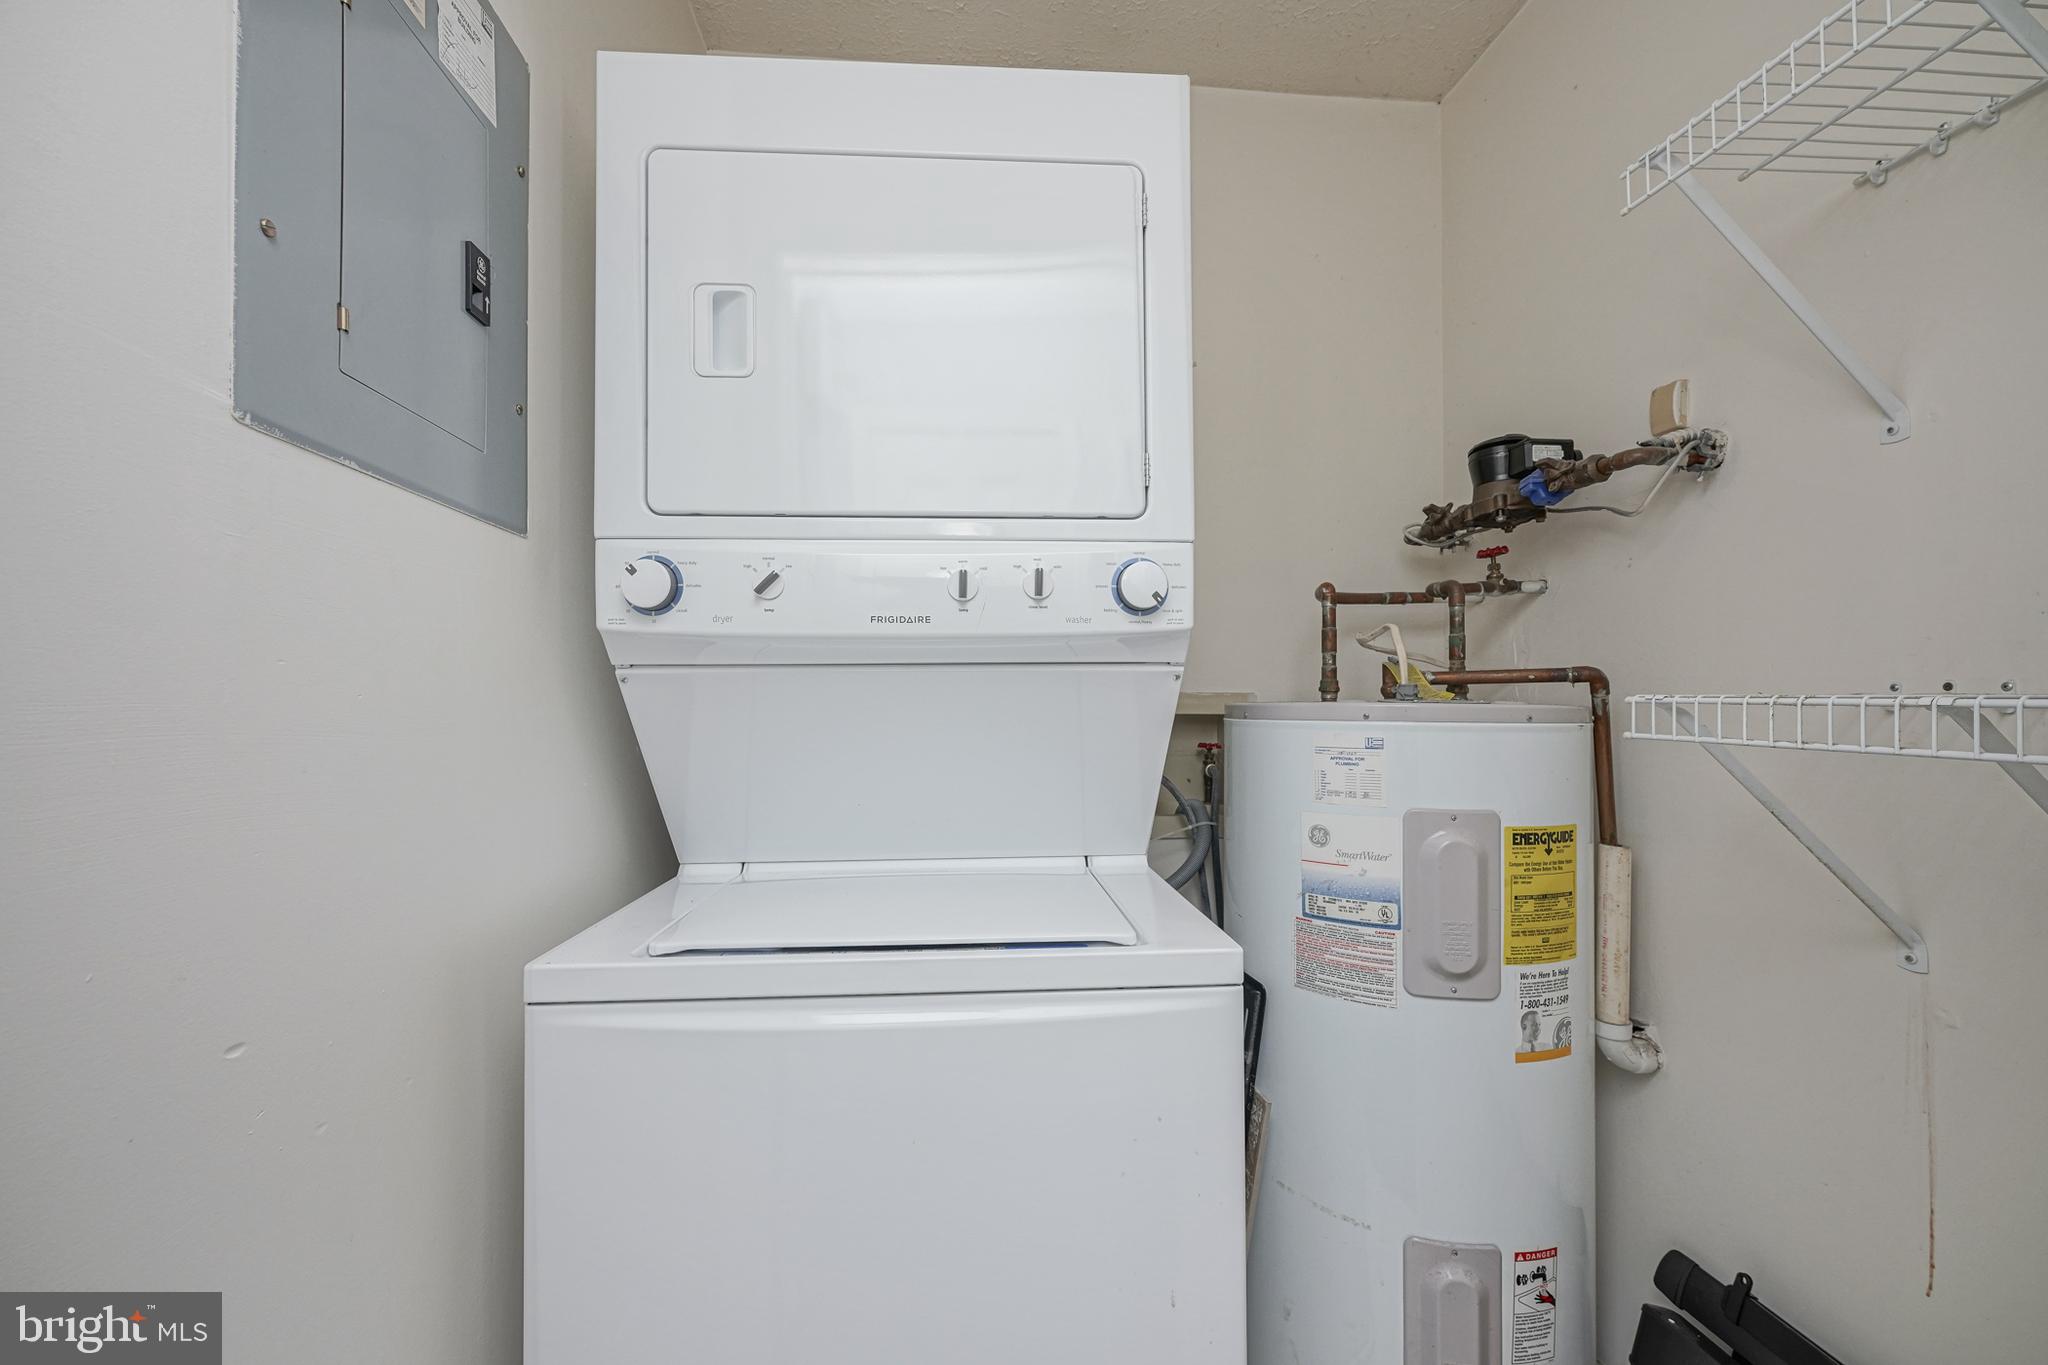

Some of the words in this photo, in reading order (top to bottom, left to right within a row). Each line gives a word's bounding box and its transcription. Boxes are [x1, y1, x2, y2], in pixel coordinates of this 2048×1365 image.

[712, 614, 734, 624] dryer
[870, 615, 932, 624] FRIGIDAIRE
[1065, 615, 1092, 624] washer
[1538, 971, 1550, 979] Here
[1525, 1249, 1556, 1260] DANGER
